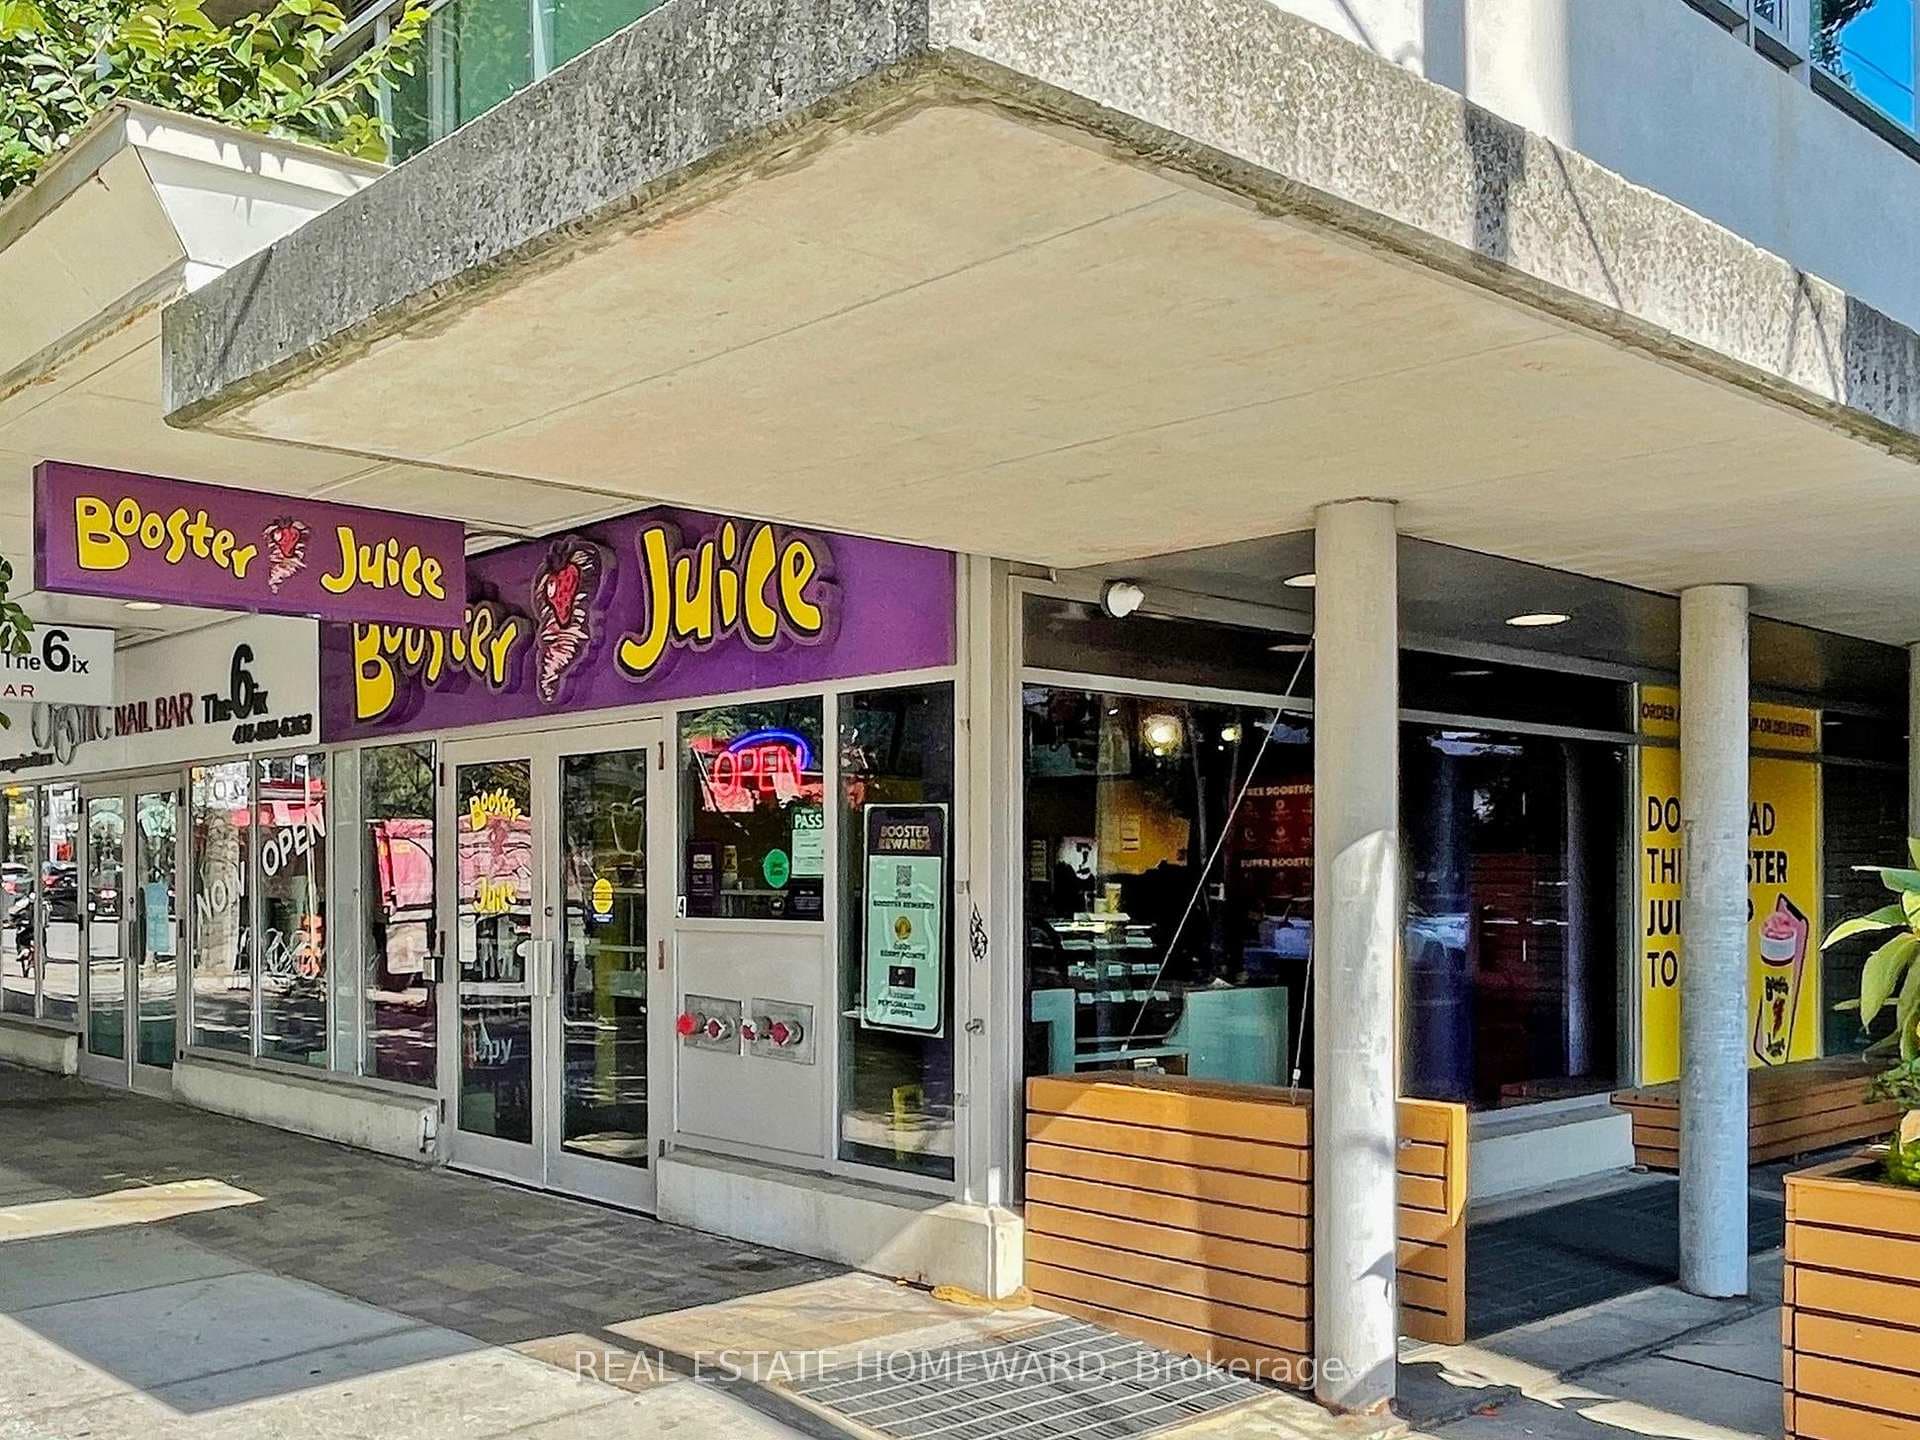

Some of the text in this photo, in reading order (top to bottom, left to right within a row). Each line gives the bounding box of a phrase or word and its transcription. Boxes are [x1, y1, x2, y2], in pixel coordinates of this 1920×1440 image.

[76, 496, 446, 600] Booster Juice
[618, 521, 822, 673] Juice
[114, 701, 153, 736] NAIL
[155, 692, 194, 729] BAR
[714, 745, 801, 796] OPEN
[262, 802, 326, 876] OPEN
[794, 813, 823, 829] PASS
[880, 825, 930, 838] BOOSTER
[1647, 952, 1678, 988] TO
